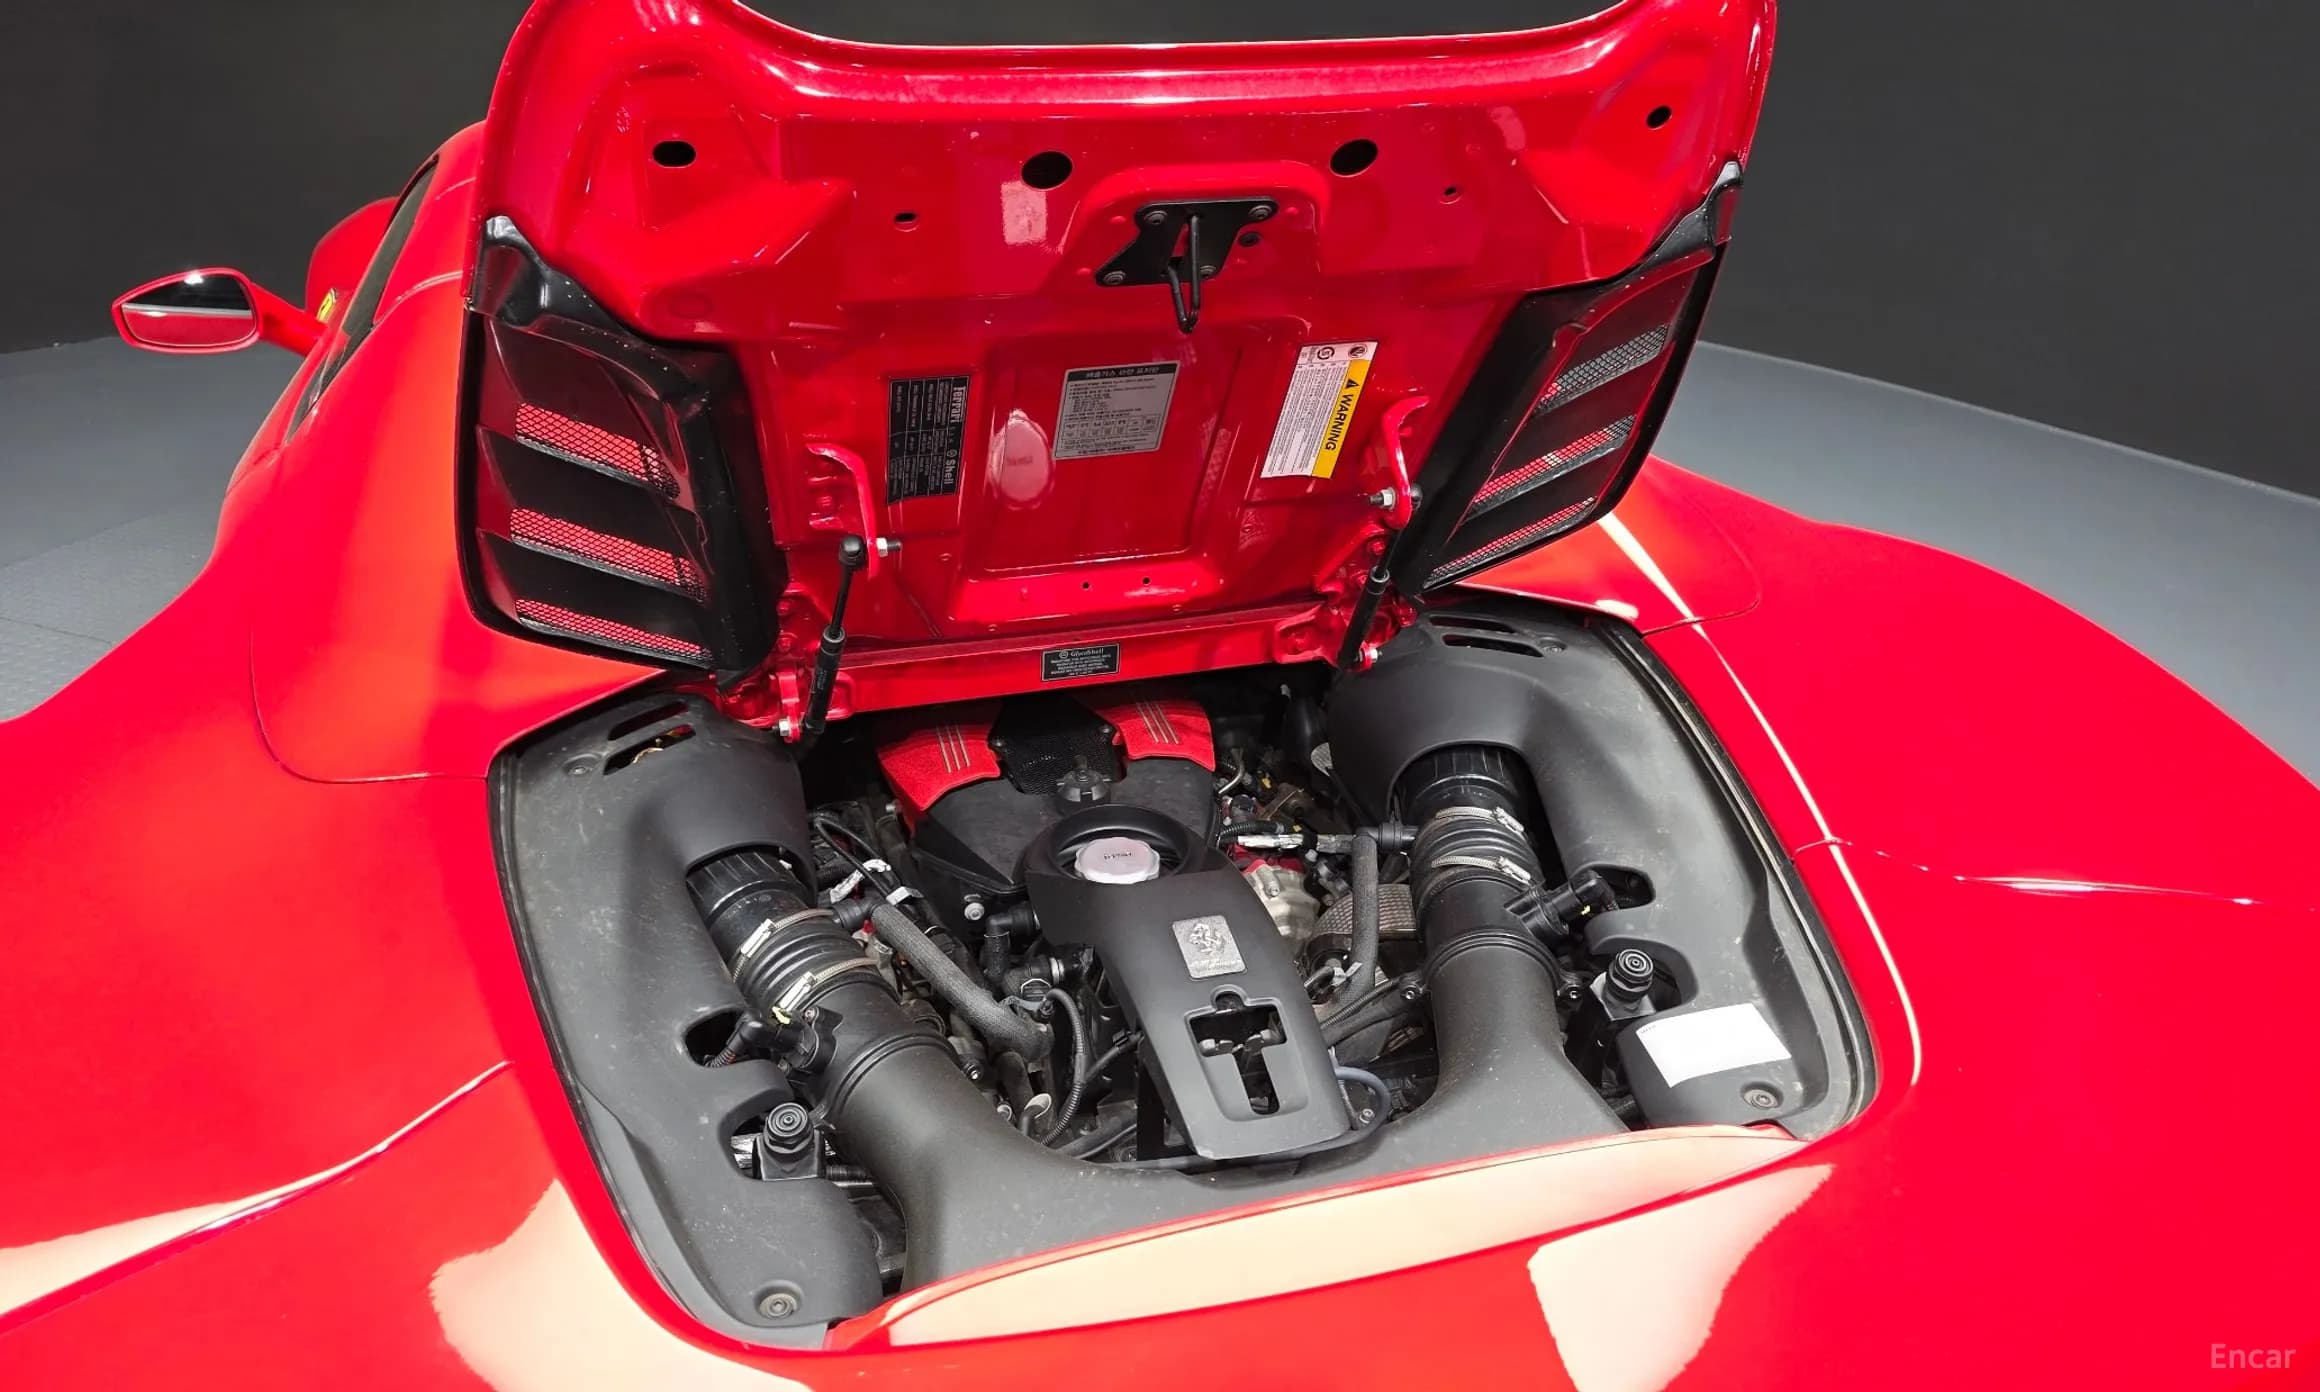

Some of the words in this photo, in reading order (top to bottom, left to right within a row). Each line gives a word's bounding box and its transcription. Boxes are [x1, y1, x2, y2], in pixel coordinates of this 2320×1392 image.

[950, 386, 966, 423] Ferrari
[1325, 394, 1354, 451] WARNING
[944, 459, 957, 485] Shell
